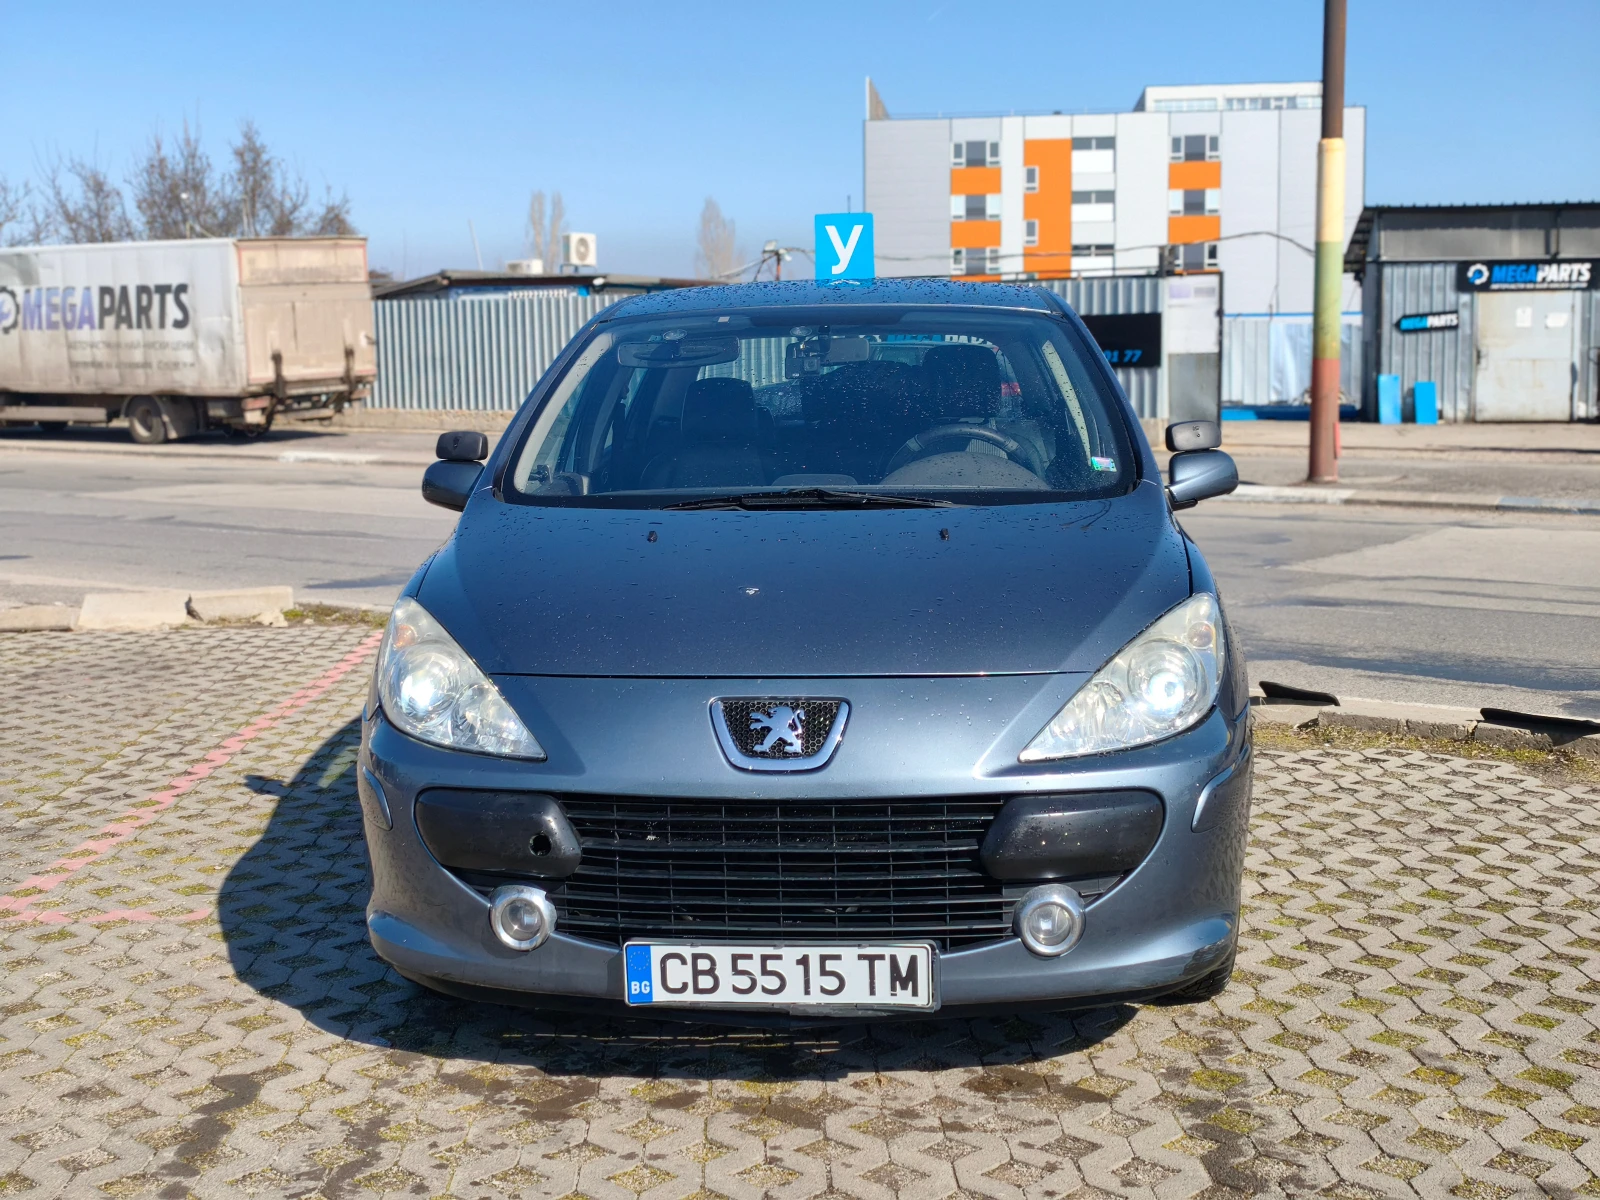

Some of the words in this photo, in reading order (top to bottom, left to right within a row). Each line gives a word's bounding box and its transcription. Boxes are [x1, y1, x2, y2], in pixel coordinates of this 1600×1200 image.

[1491, 263, 1592, 284] MEGAPARTS
[22, 283, 190, 331] MEGAPARTS
[1123, 349, 1143, 363] 77
[660, 952, 721, 995] CB
[731, 953, 847, 996] 5515
[857, 953, 920, 997] TM
[631, 981, 651, 994] BG
